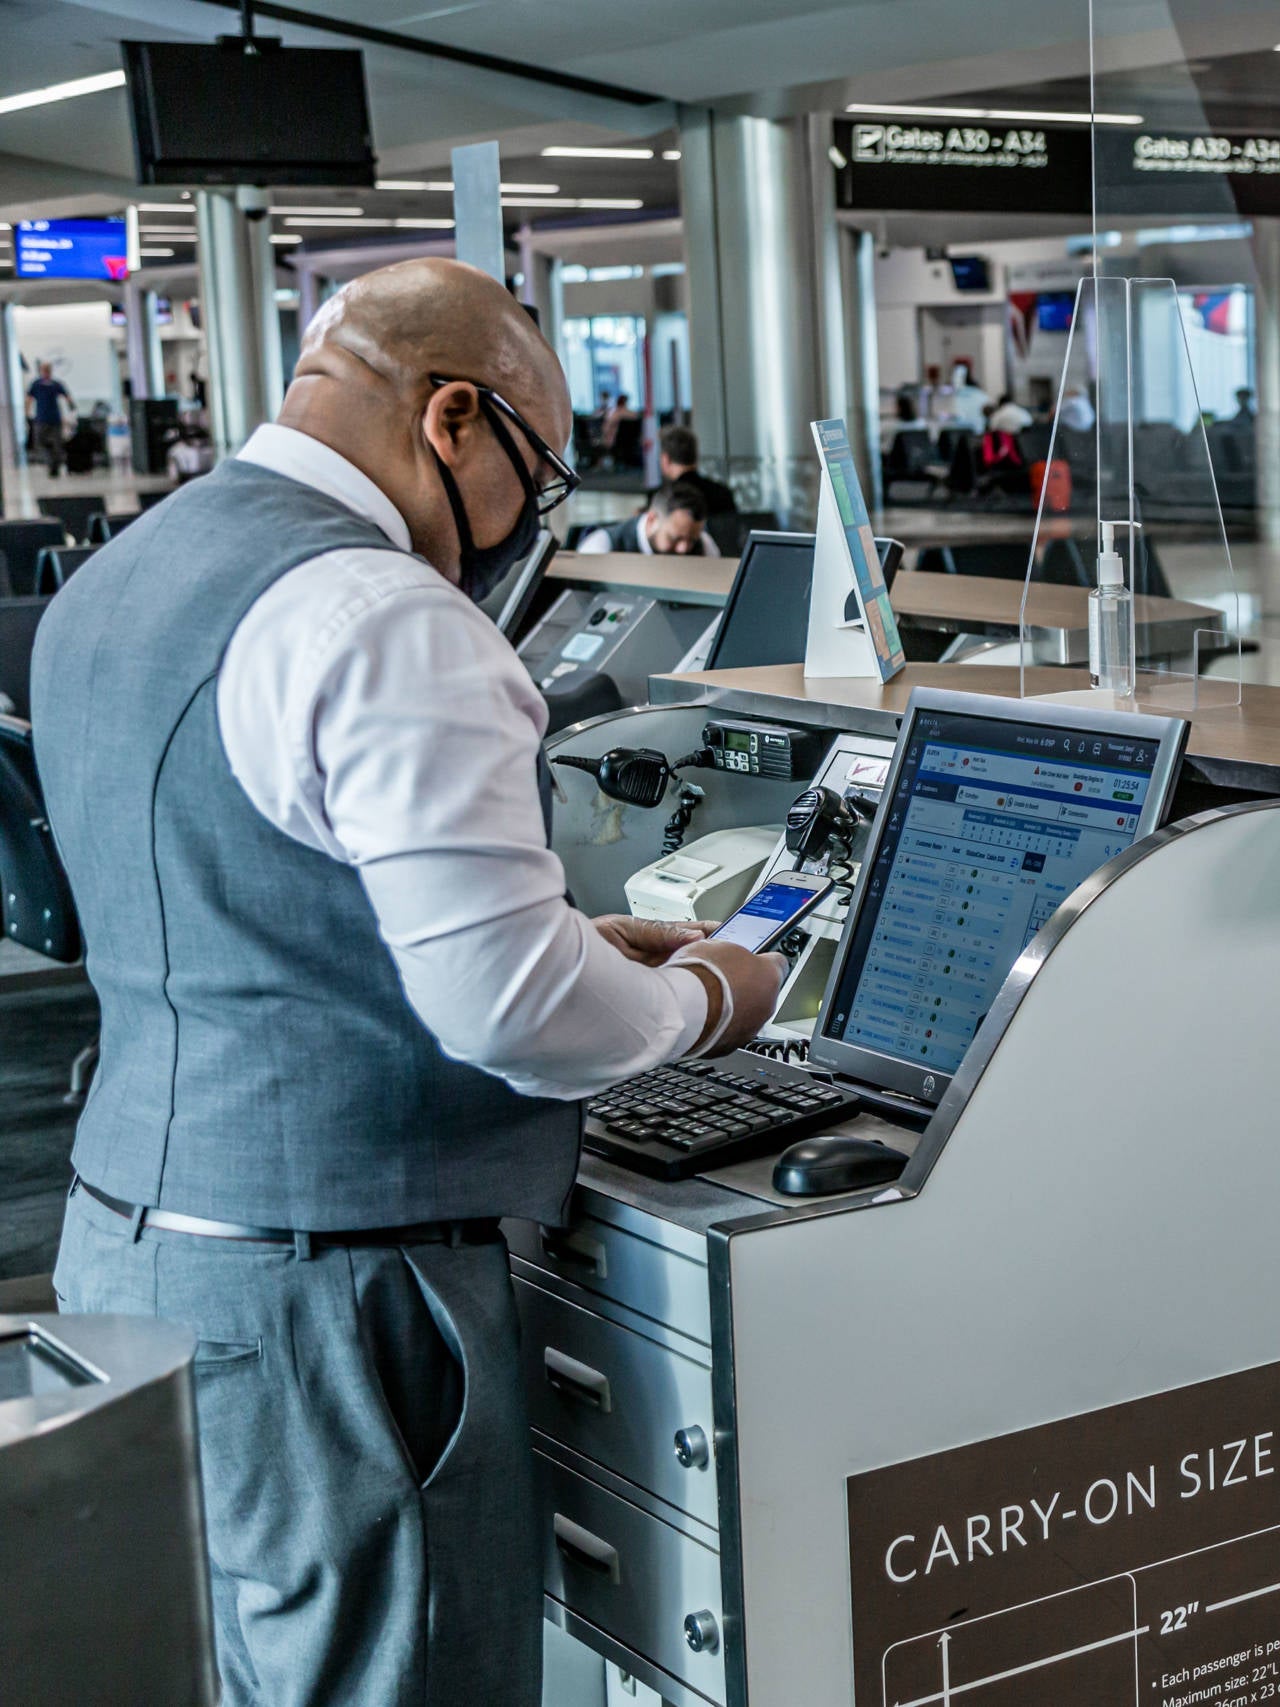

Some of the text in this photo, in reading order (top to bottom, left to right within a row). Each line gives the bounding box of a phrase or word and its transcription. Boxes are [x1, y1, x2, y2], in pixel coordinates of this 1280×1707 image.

[886, 124, 944, 150] Gates
[945, 128, 990, 152] A30
[1003, 130, 1047, 154] A34
[1134, 136, 1189, 159] Gates
[1190, 137, 1231, 160] A30
[1243, 139, 1280, 162] A34
[884, 1465, 1157, 1583] CARRY-ON
[1180, 1431, 1275, 1498] SIZE
[1161, 1667, 1190, 1688] Each
[1193, 1649, 1252, 1680] passenger
[1254, 1643, 1263, 1656] is
[1162, 1684, 1222, 1707] Maximum
[1224, 1675, 1249, 1691] size:
[1250, 1692, 1258, 1703] x
[1260, 1683, 1275, 1699] 23
